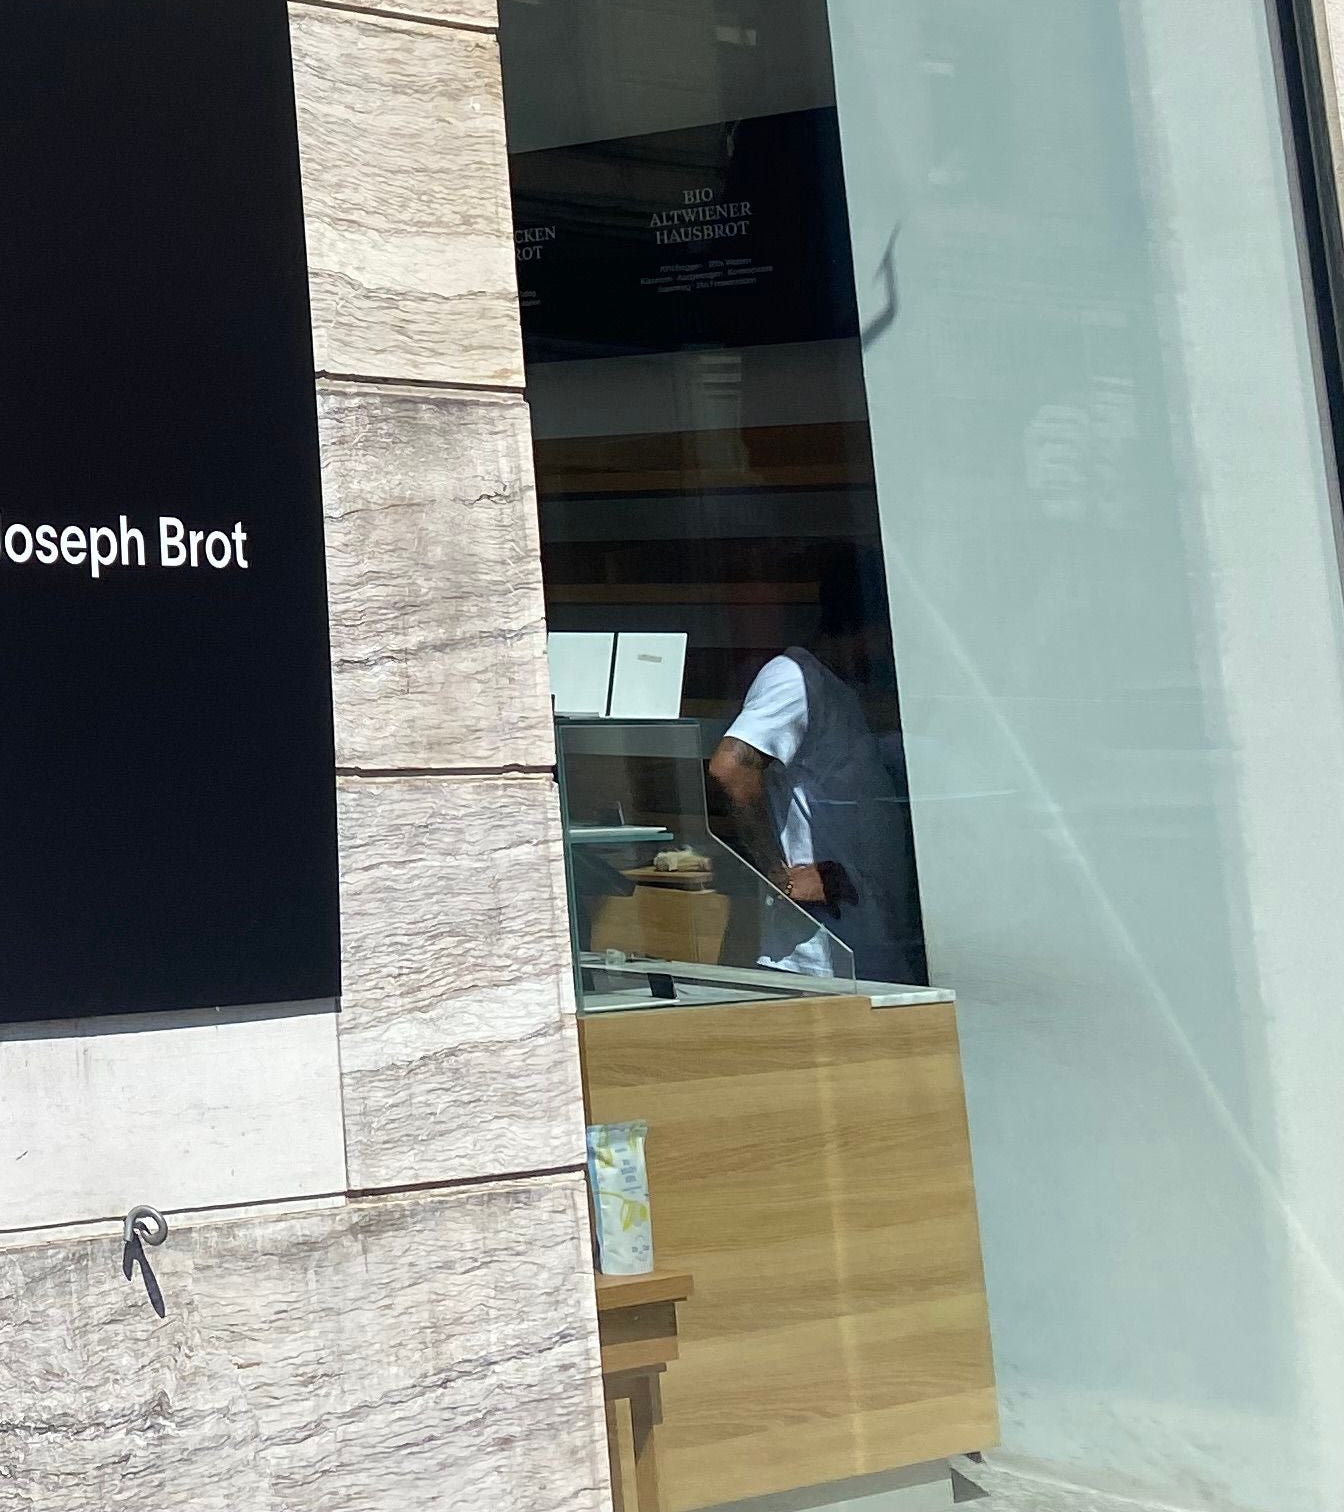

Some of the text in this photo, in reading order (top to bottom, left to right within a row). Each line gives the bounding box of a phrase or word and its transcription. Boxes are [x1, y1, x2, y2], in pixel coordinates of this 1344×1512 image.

[683, 188, 713, 204] BIO
[650, 201, 752, 228] ALTWIENER
[656, 220, 750, 245] HAUSBROT
[160, 517, 248, 568] Brot
